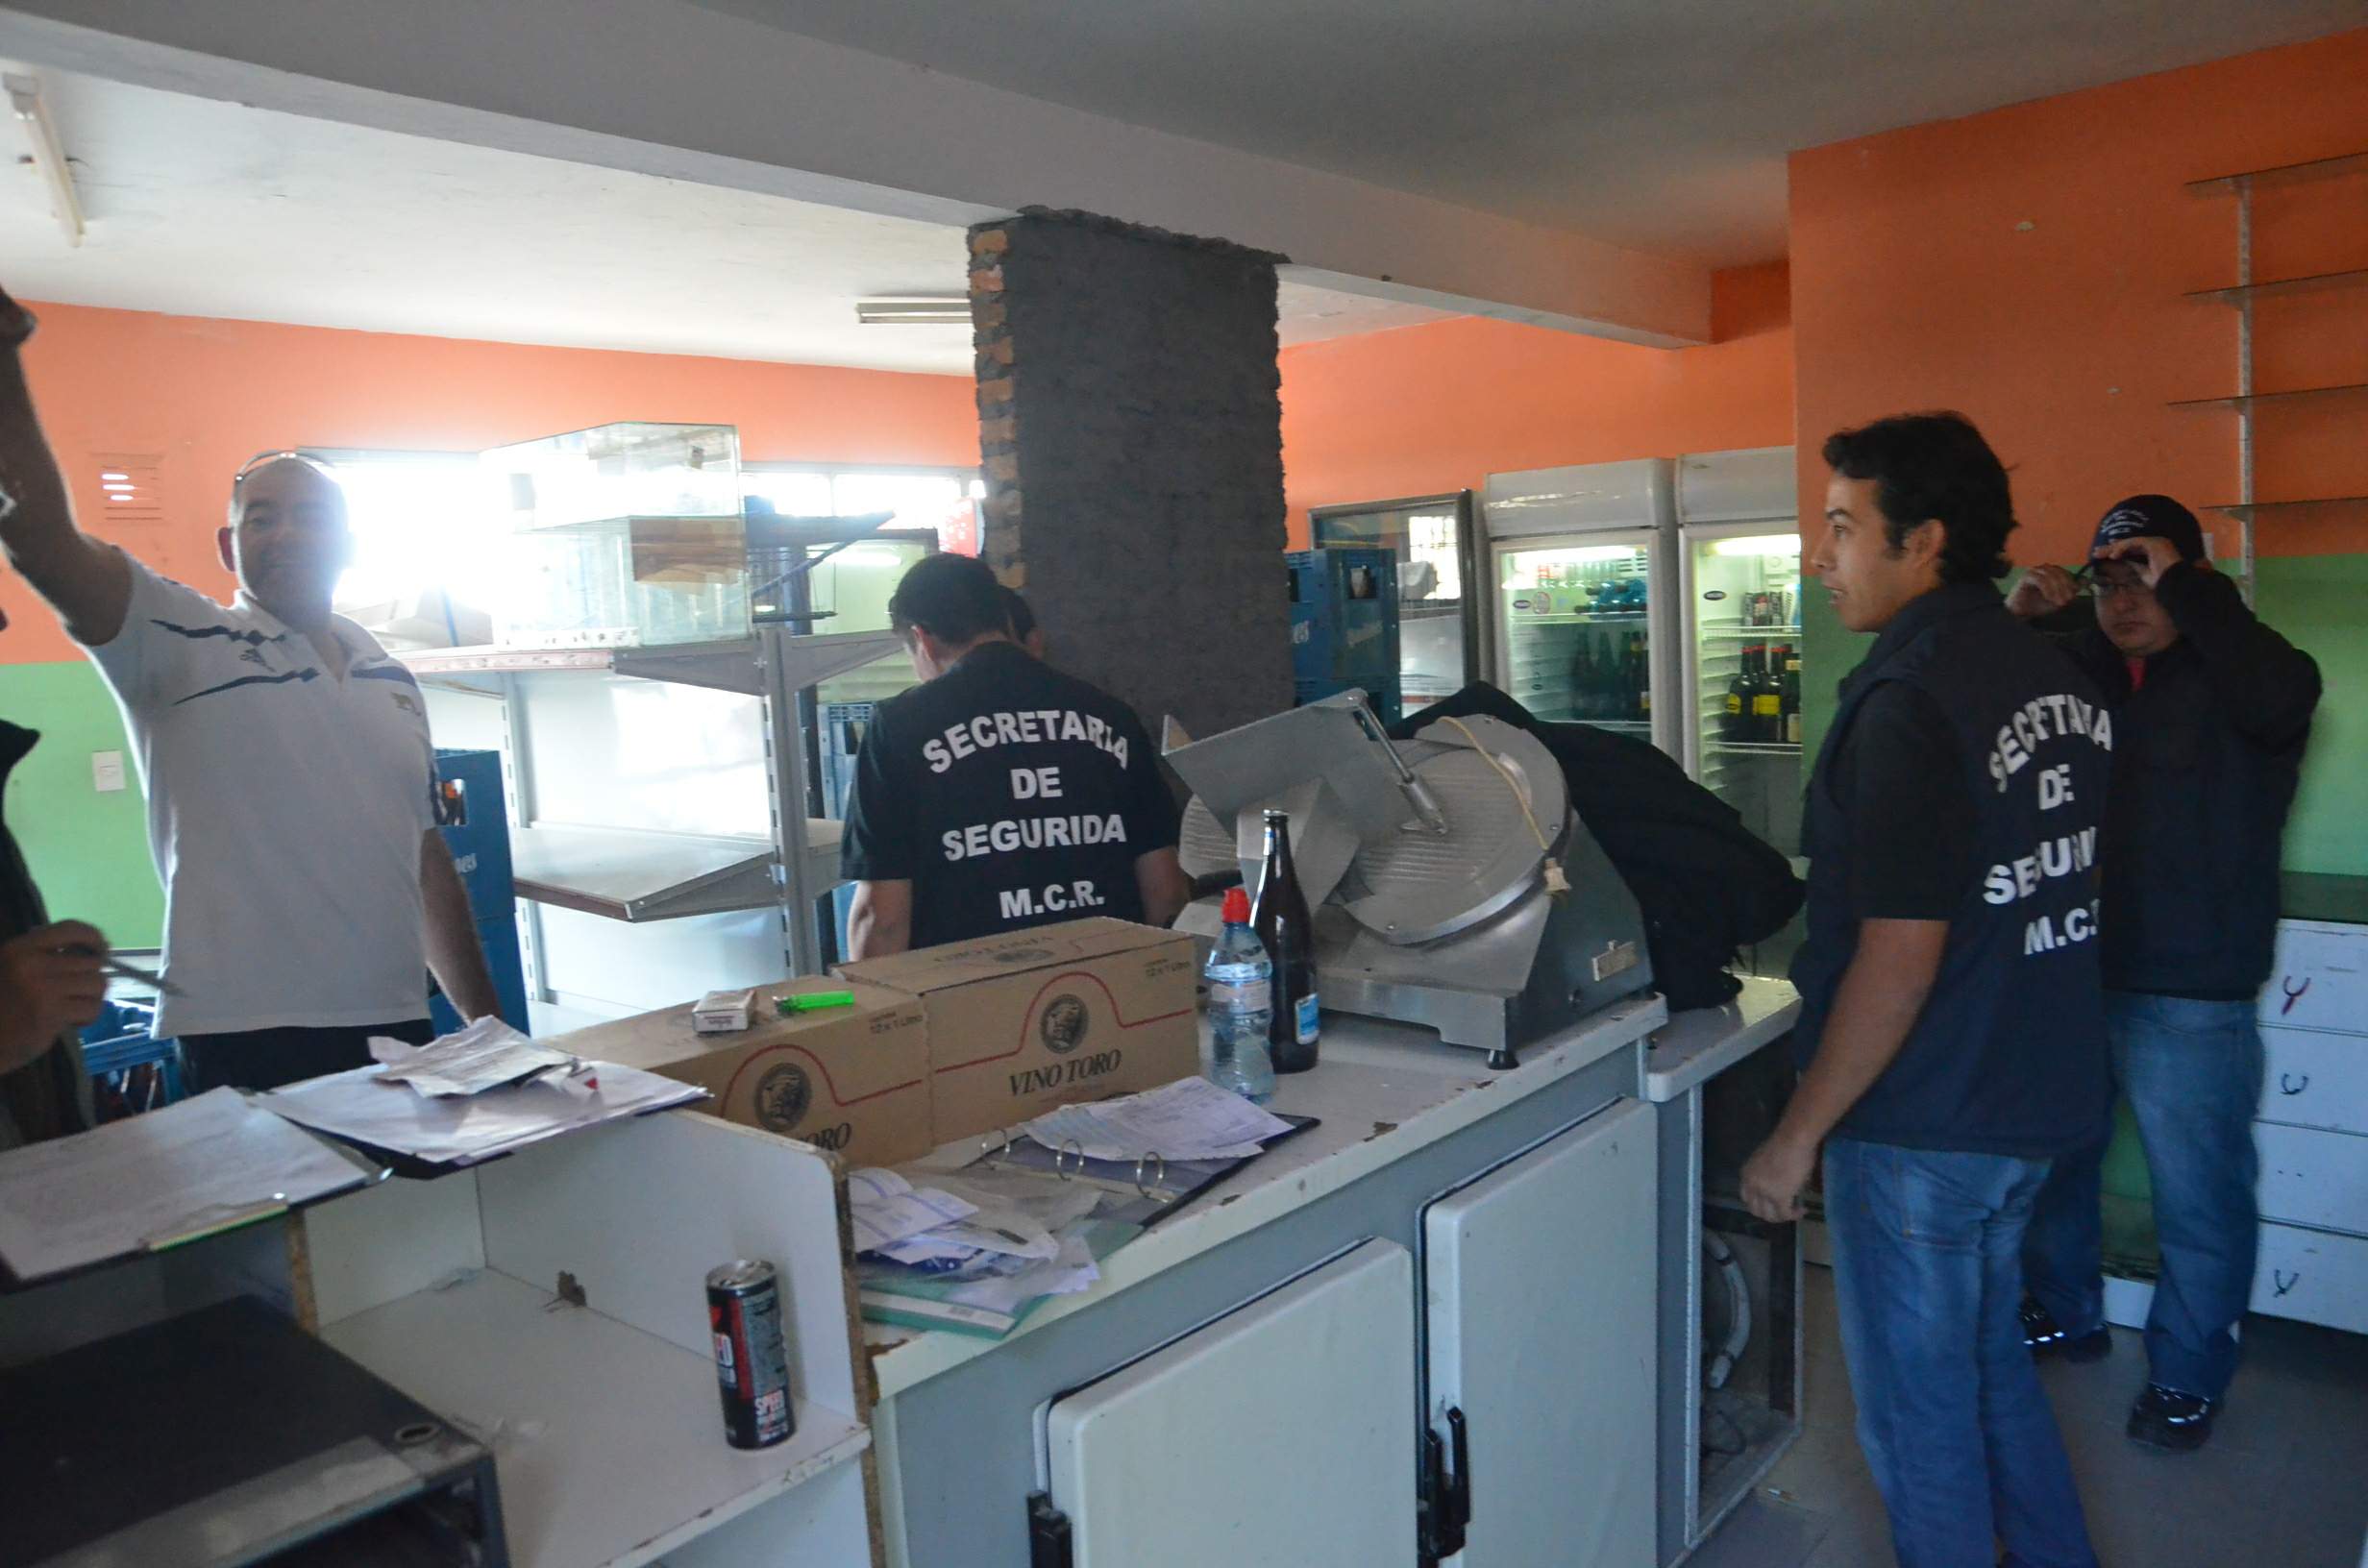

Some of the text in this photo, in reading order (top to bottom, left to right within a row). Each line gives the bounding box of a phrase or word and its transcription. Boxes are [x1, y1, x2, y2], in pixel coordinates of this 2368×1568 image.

[923, 710, 1128, 773] SECRETARIA
[1010, 767, 1063, 799] DE
[942, 815, 1127, 862] SEGURIDA
[999, 880, 1105, 919] M.C.R.
[1009, 1048, 1122, 1096] VINO TORO
[799, 1122, 851, 1151] ORO
